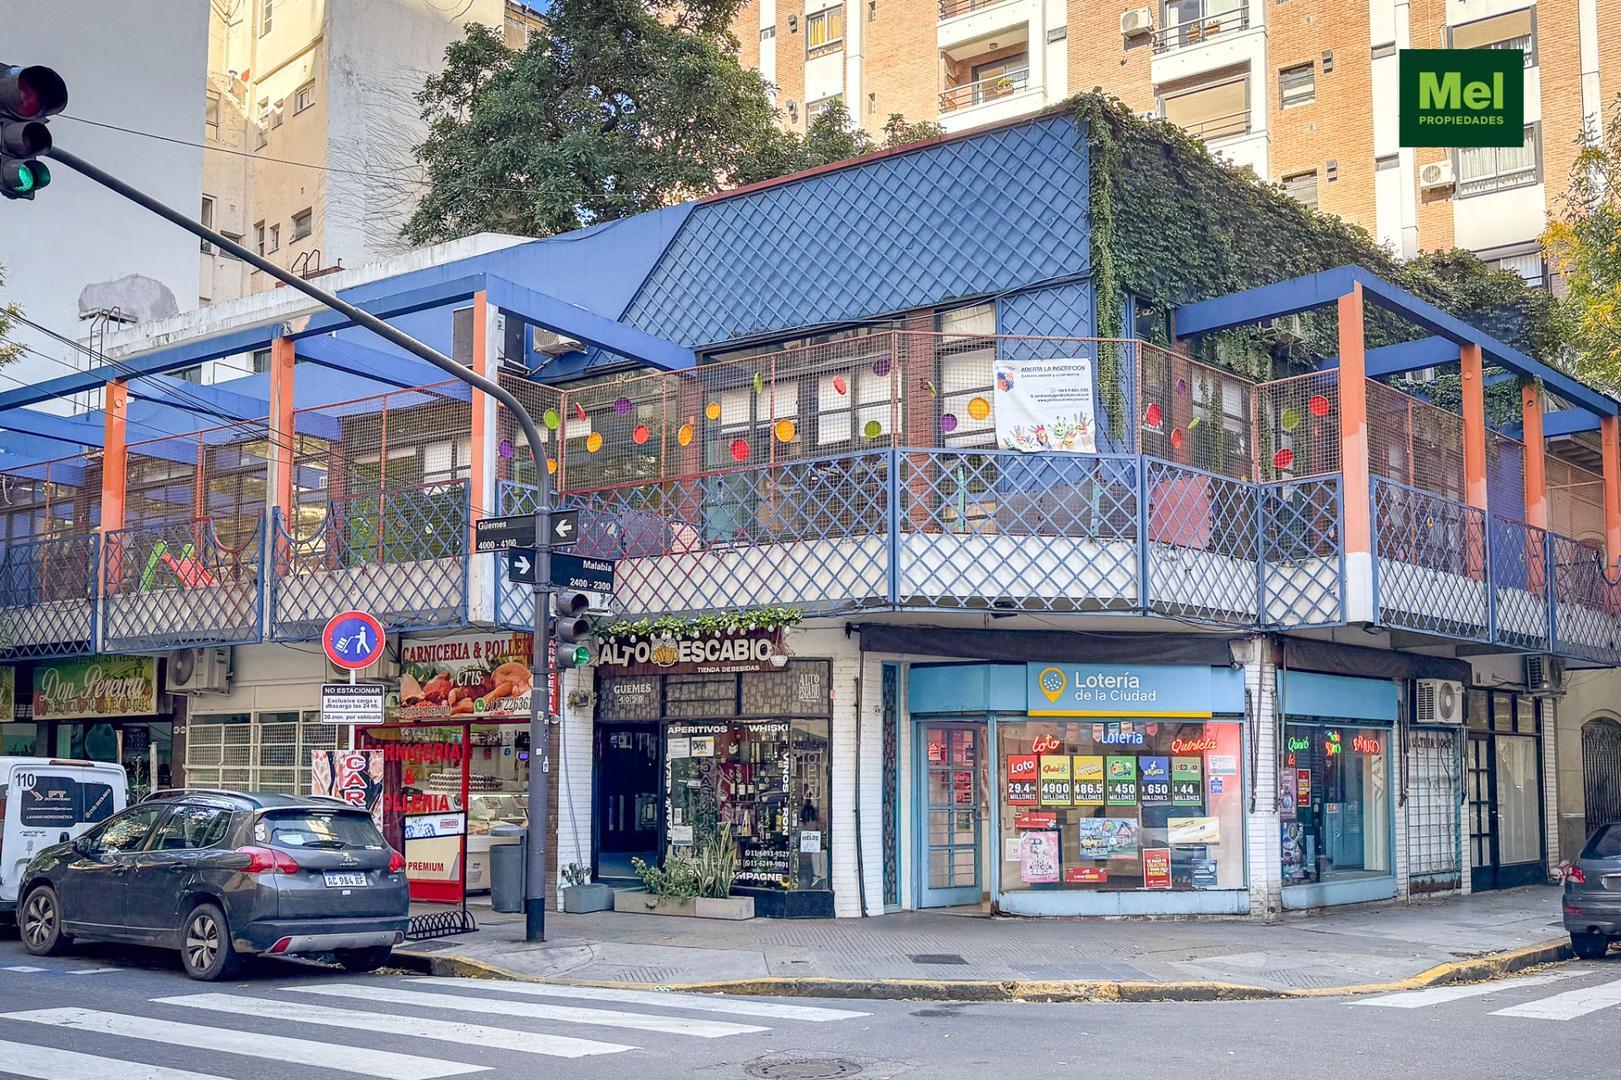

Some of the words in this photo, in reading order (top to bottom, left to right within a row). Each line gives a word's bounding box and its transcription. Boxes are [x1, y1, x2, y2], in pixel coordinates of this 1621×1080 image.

[478, 520, 507, 531] Güemes
[478, 540, 495, 549] 4000
[501, 539, 517, 548] 4100
[583, 560, 612, 572] Malabia
[570, 577, 588, 588] 2400
[402, 642, 470, 664] CARNICERIA
[473, 641, 482, 658] &
[484, 638, 534, 658] POLLER
[599, 641, 650, 667] ALTO
[679, 638, 773, 663] ESCABIO
[456, 666, 482, 687] Cris
[548, 638, 556, 712] ARNICERIA
[1075, 671, 1140, 688] Lotería
[40, 667, 77, 702] Don
[613, 684, 652, 694] GUEMES
[1075, 689, 1091, 701] de
[1095, 690, 1106, 701] la
[1110, 690, 1157, 702] Ciudad
[667, 725, 728, 734] APERITIVOS
[748, 724, 789, 733] WHISKI
[1032, 734, 1060, 753] Loto
[1011, 760, 1034, 774] Loto
[15, 773, 35, 787] 110
[345, 755, 367, 806] CAR
[1042, 783, 1069, 793] 4900
[1115, 784, 1135, 794] 450
[1148, 784, 1168, 794] 650
[1180, 784, 1194, 794] 44
[384, 792, 450, 812] OLLERIA
[408, 861, 444, 872] PREMIUM
[732, 872, 783, 881] AMPAGNE
